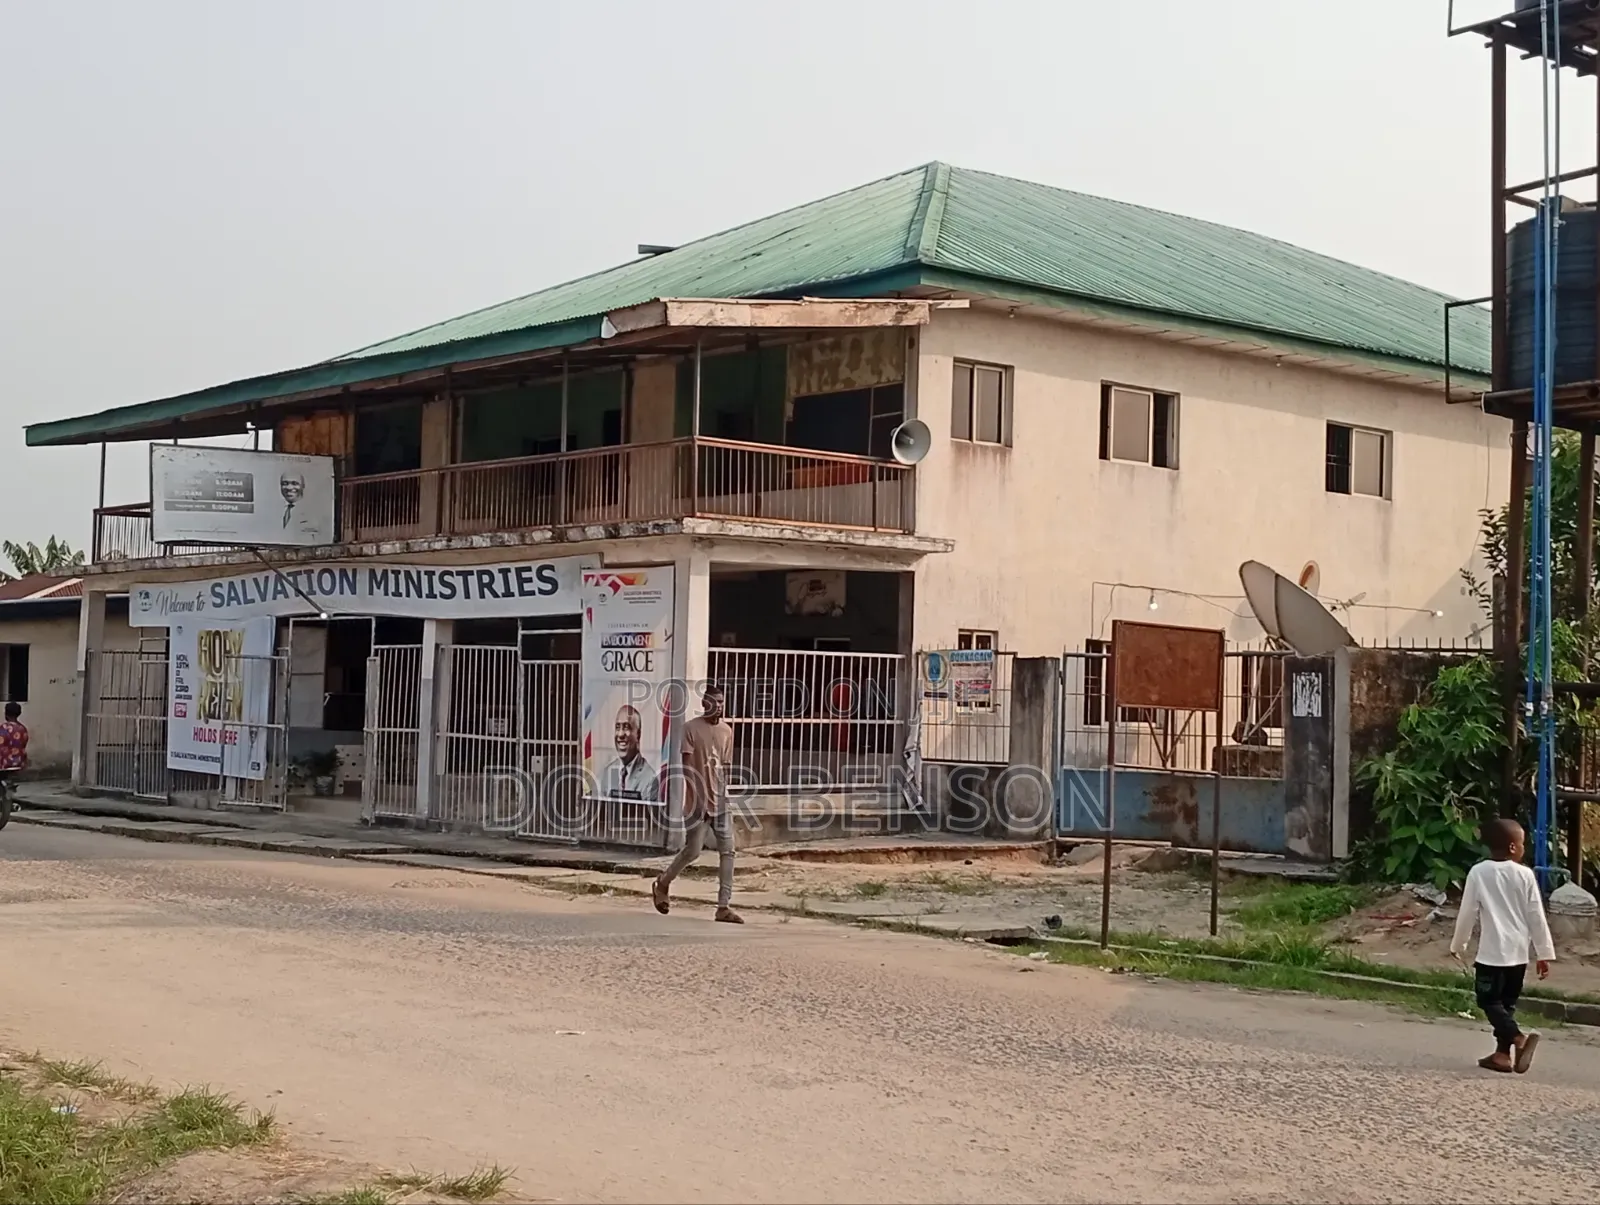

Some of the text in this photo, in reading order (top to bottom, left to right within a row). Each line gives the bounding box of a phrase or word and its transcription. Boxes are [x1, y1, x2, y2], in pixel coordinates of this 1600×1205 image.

[155, 592, 195, 616] Welcome
[195, 592, 206, 611] to
[210, 568, 357, 609] SALVATION
[367, 563, 558, 600] MINISTRIES
[601, 650, 654, 673] GRACE
[193, 726, 217, 744] HOLDS
